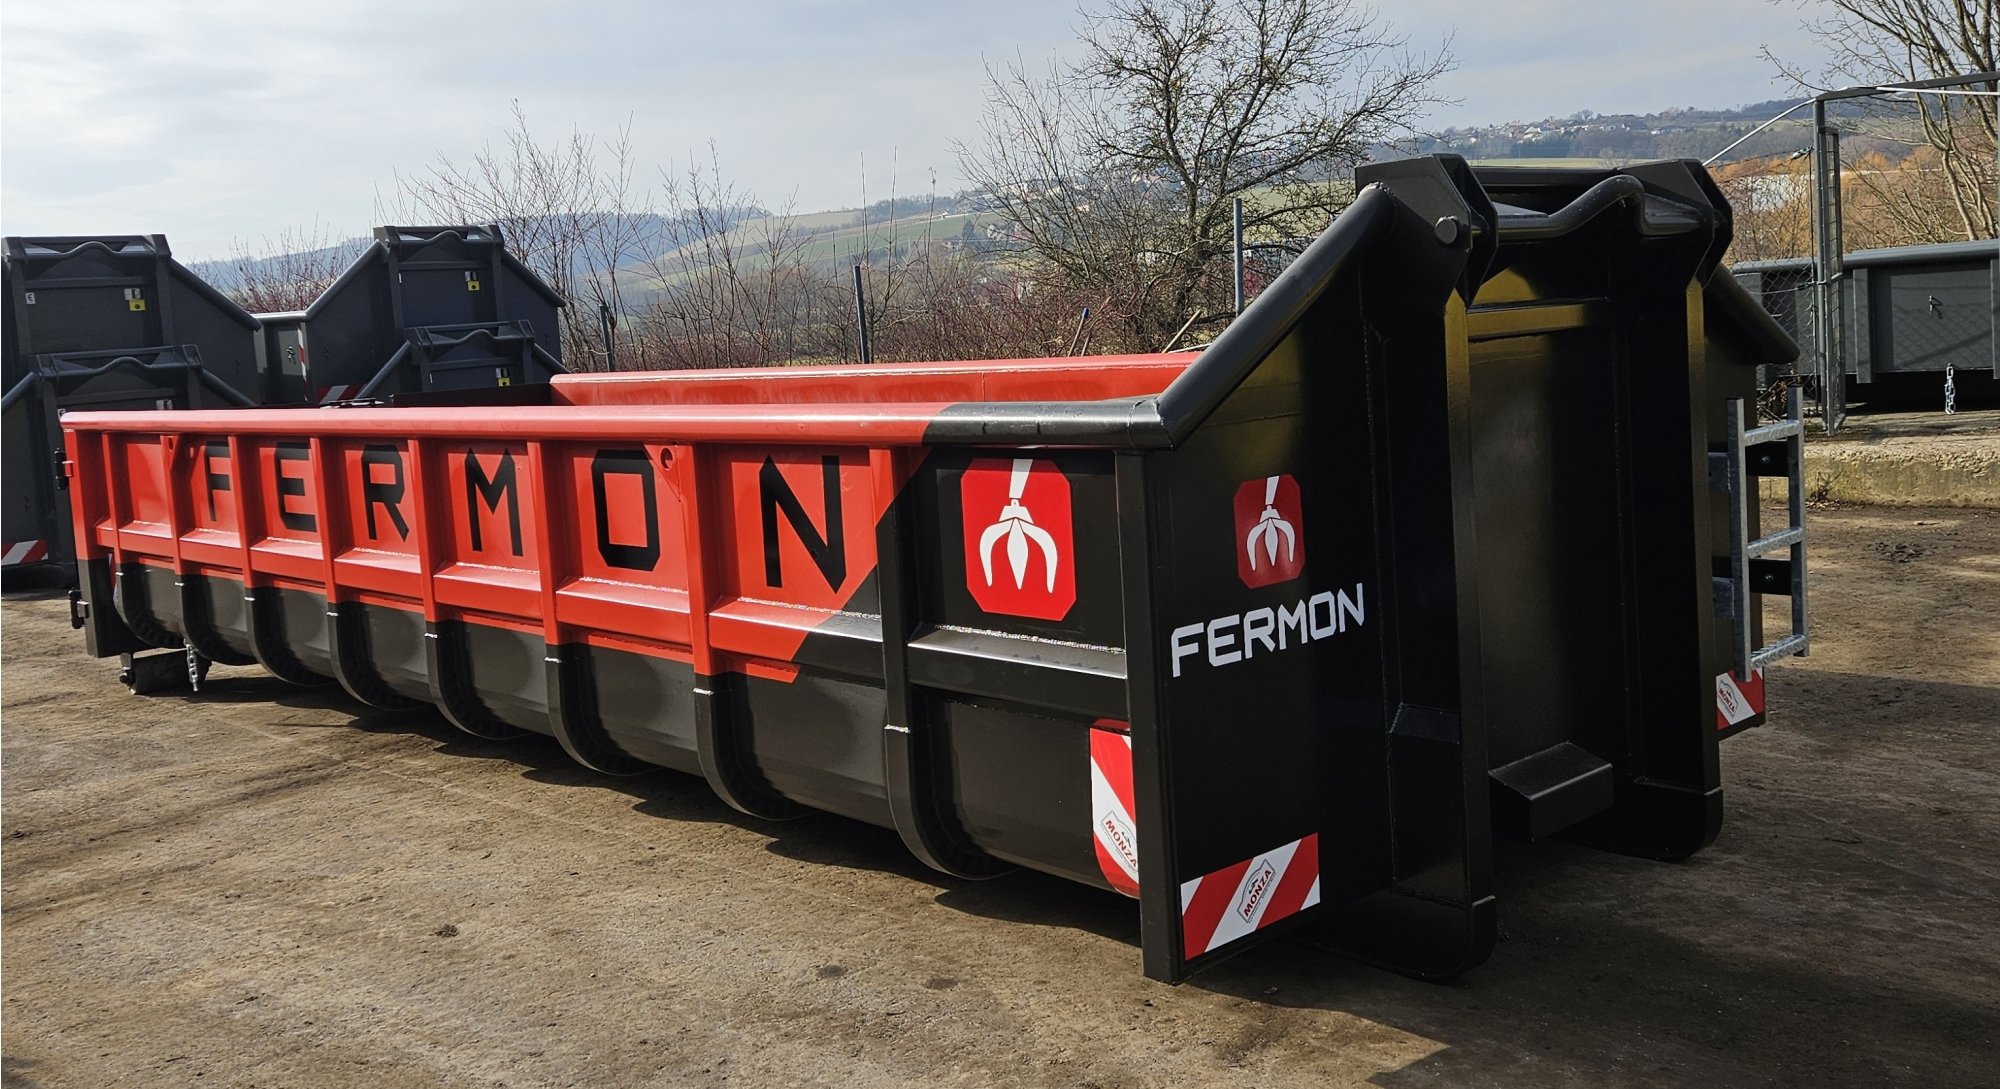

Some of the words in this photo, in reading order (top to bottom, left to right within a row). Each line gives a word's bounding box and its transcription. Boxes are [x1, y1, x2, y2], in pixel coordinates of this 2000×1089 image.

[204, 441, 847, 593] FERMON
[1171, 582, 1365, 678] FERMON
[1105, 820, 1137, 868] MONZA
[1243, 869, 1272, 917] MONZA
